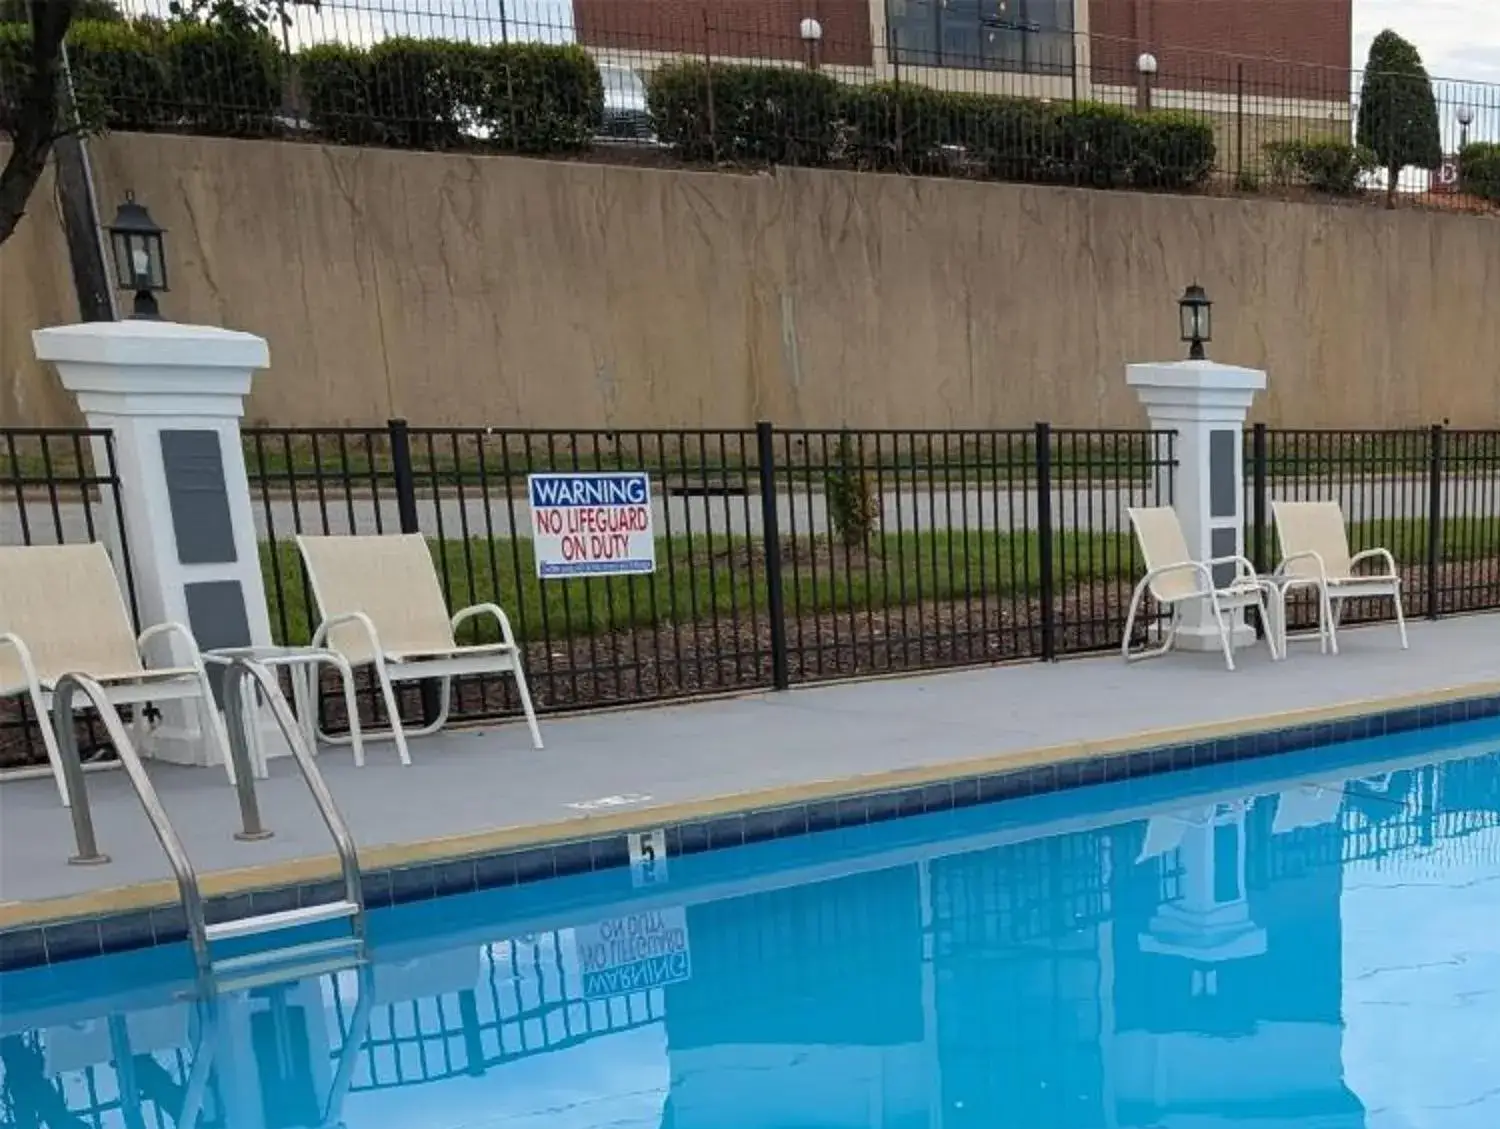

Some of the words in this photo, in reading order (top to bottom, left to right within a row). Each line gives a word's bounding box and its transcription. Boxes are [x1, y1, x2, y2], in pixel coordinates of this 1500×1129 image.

[534, 479, 645, 504] WARNING
[536, 509, 562, 534] NO
[567, 507, 648, 533] LIFEGUARD
[561, 536, 586, 560] ON
[592, 534, 629, 559] DUTY
[640, 833, 655, 861] 5
